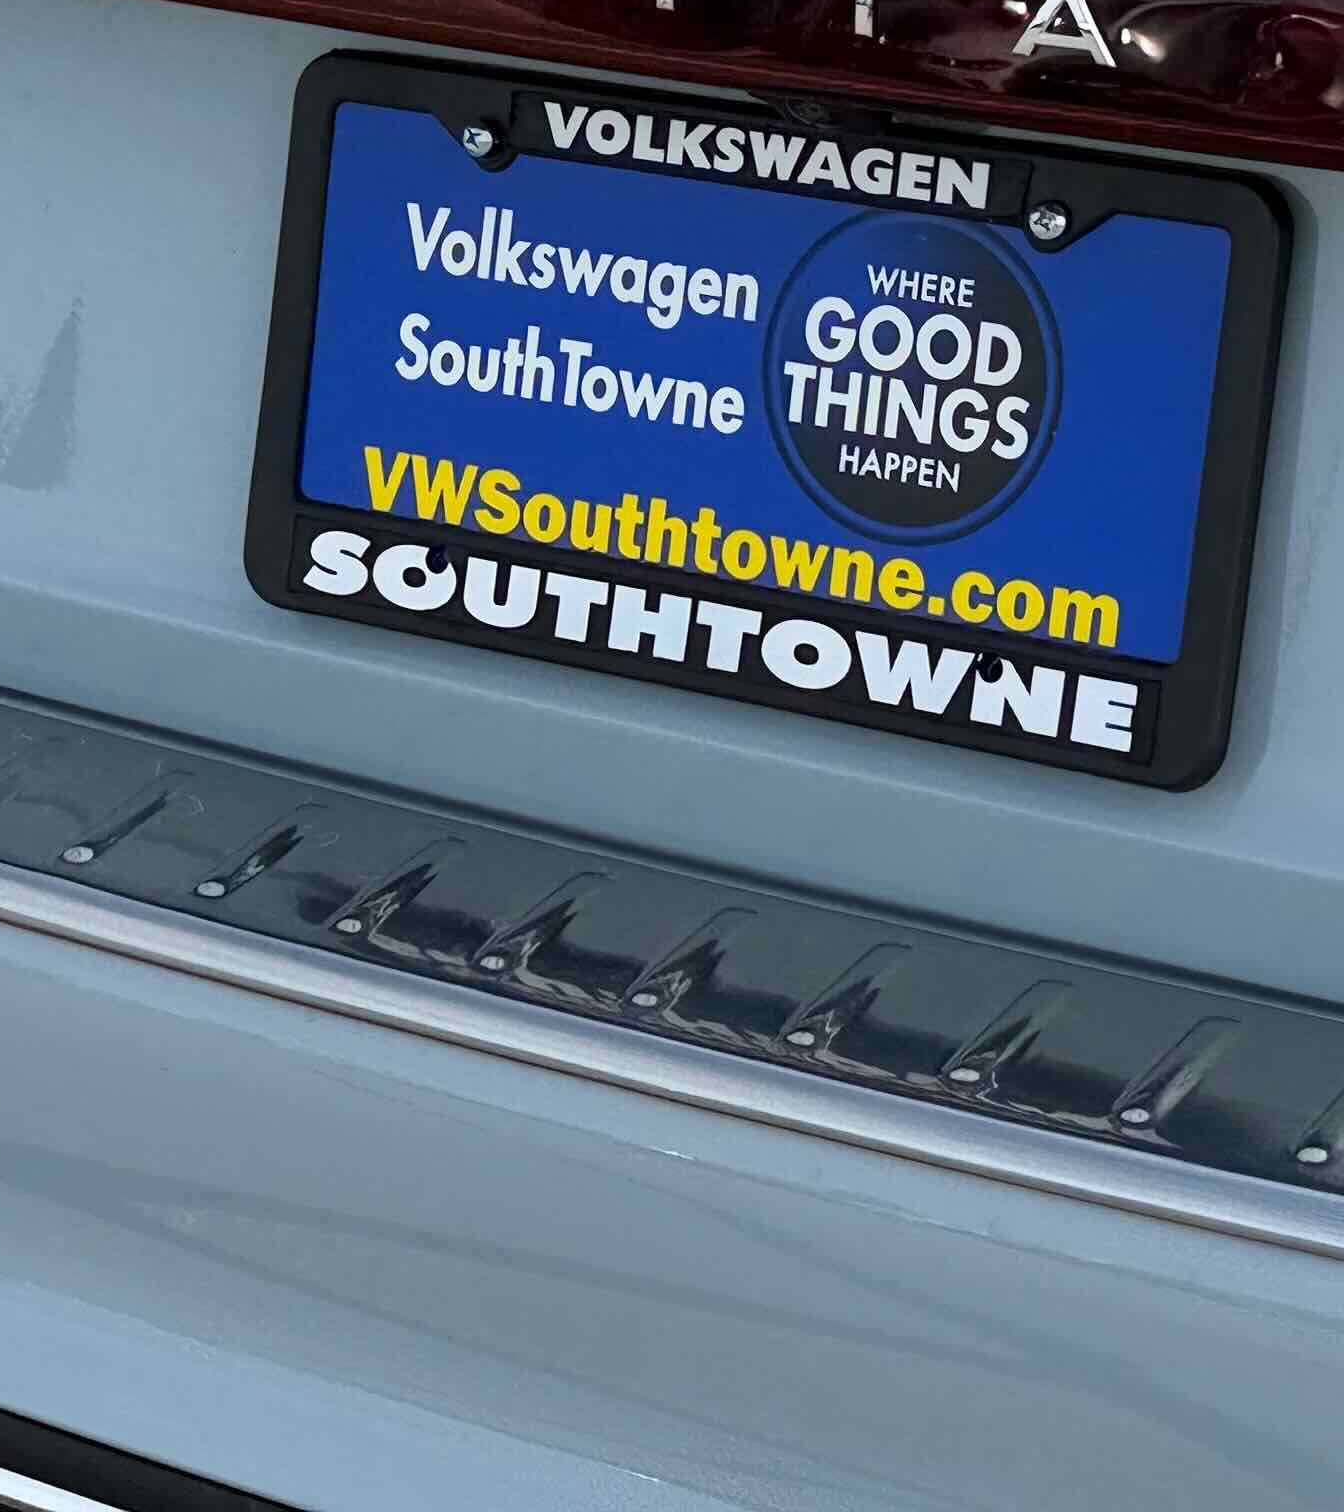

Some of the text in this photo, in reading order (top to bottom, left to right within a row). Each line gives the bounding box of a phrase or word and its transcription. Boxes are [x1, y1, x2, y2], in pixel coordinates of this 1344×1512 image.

[542, 100, 991, 210] VOLKSWAGEN
[405, 201, 760, 330] Volkswagen
[866, 263, 976, 309] WHERE
[394, 311, 746, 435] SouthTowne
[804, 295, 1023, 388] GOOD
[782, 360, 1031, 461] THINGS
[837, 443, 962, 494] HAPPEN
[363, 445, 1121, 649] VWSouthtowne.com
[302, 529, 1139, 754] SOUTHTOWNE
